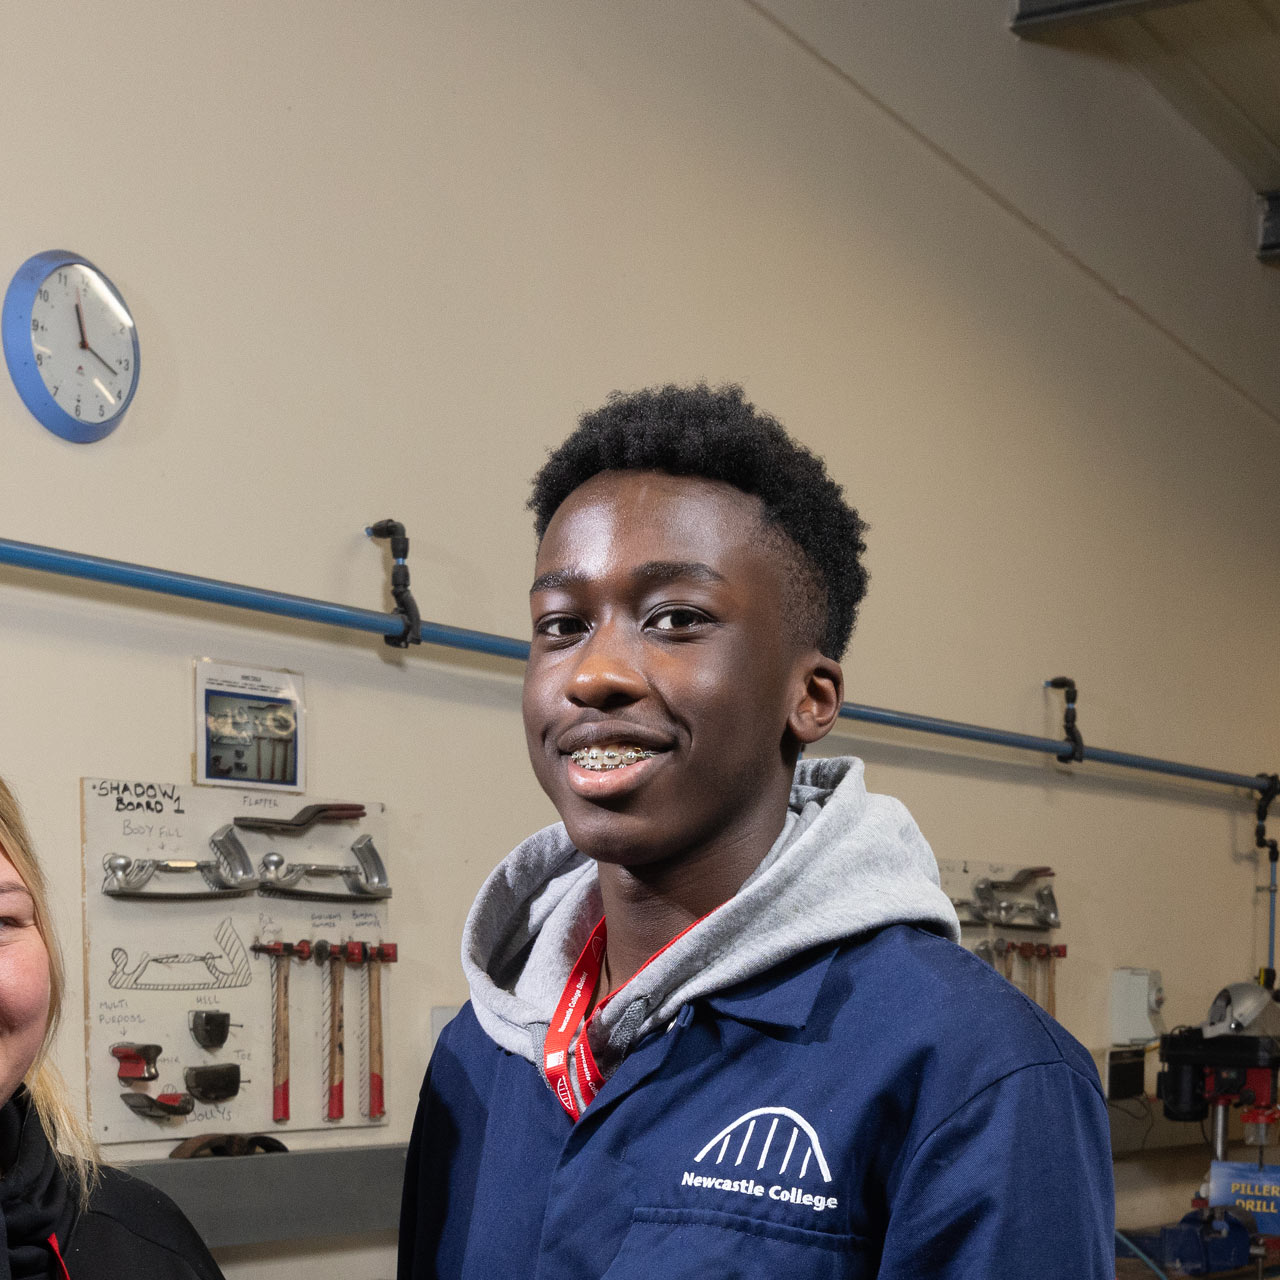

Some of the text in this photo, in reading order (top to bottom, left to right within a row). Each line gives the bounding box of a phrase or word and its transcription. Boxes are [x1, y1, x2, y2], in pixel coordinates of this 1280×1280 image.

[58, 272, 68, 287] 11
[38, 288, 49, 302] 10
[32, 319, 39, 332] 9
[36, 354, 43, 367] 8
[123, 359, 130, 371] 3
[53, 385, 59, 398] 7
[75, 404, 82, 418] 6
[98, 404, 105, 418] 5
[98, 781, 175, 799] SHADOW
[115, 797, 185, 813] BOARD 1
[579, 1044, 592, 1081] Newcastle
[681, 1172, 838, 1212] Newcastle College
[1231, 1183, 1280, 1197] PILLER
